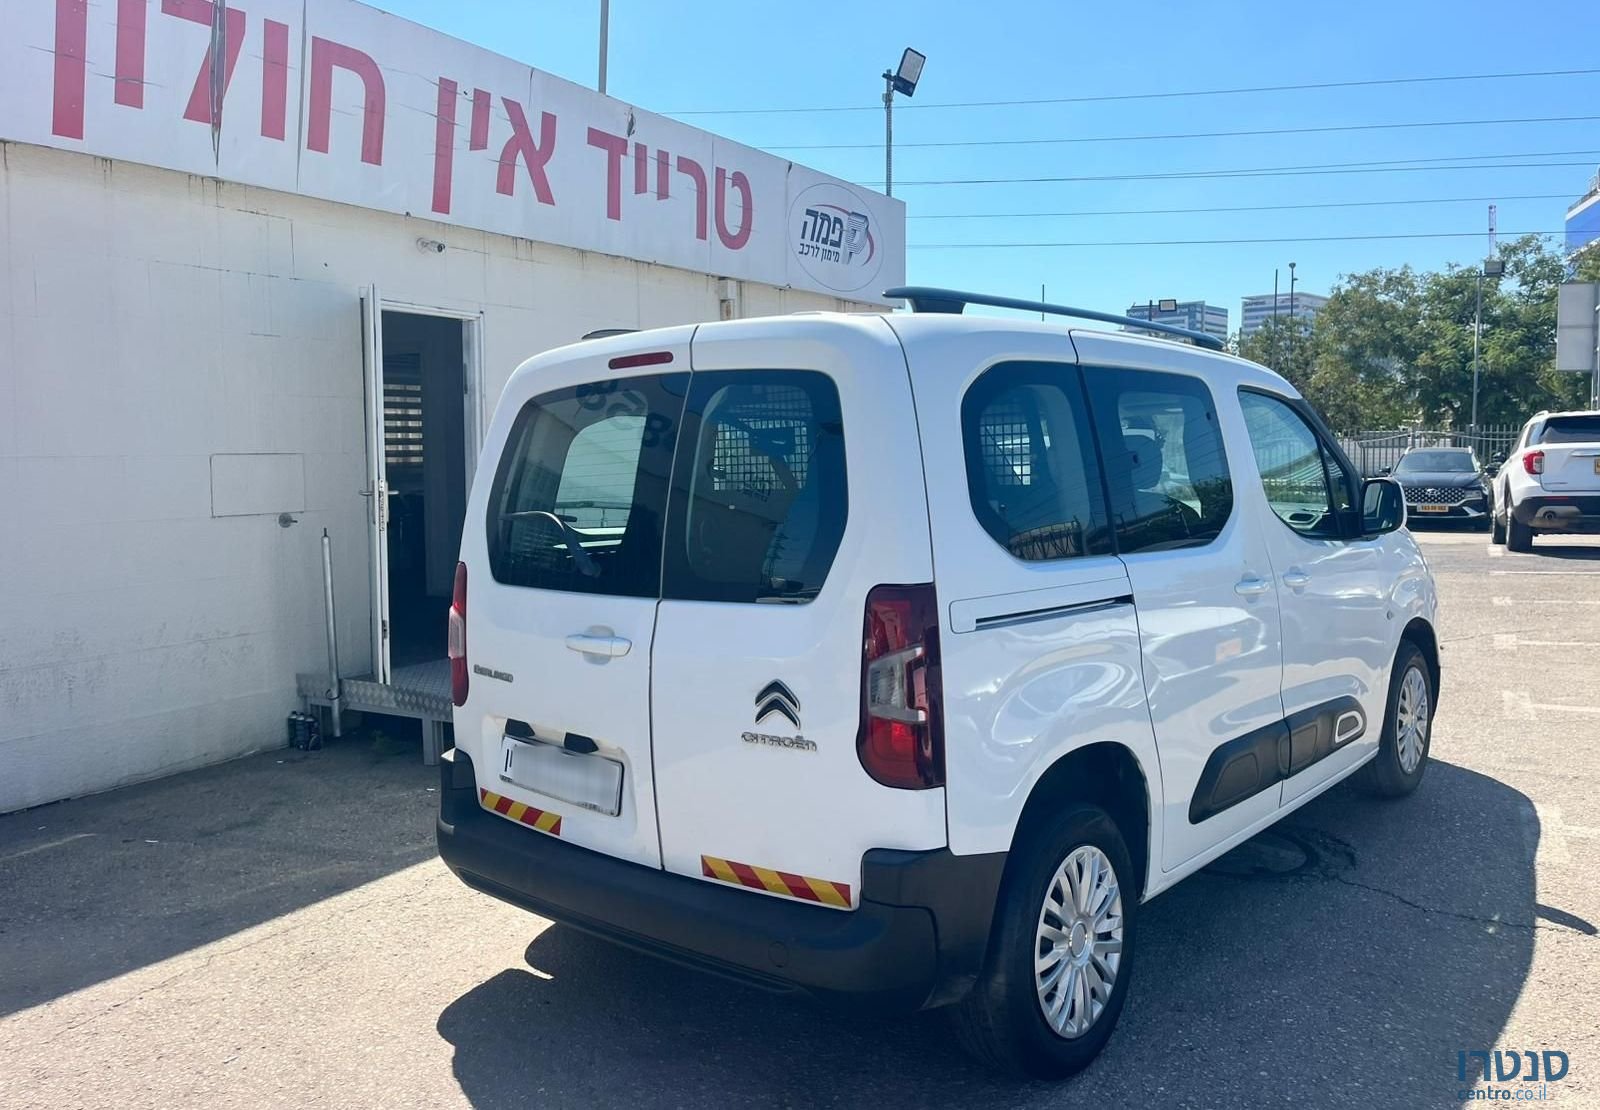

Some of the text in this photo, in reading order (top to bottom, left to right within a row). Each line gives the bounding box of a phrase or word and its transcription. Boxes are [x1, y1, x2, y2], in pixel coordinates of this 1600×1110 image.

[52, 0, 753, 251] טרייד אין חולון
[798, 243, 840, 263] מימון לרכב
